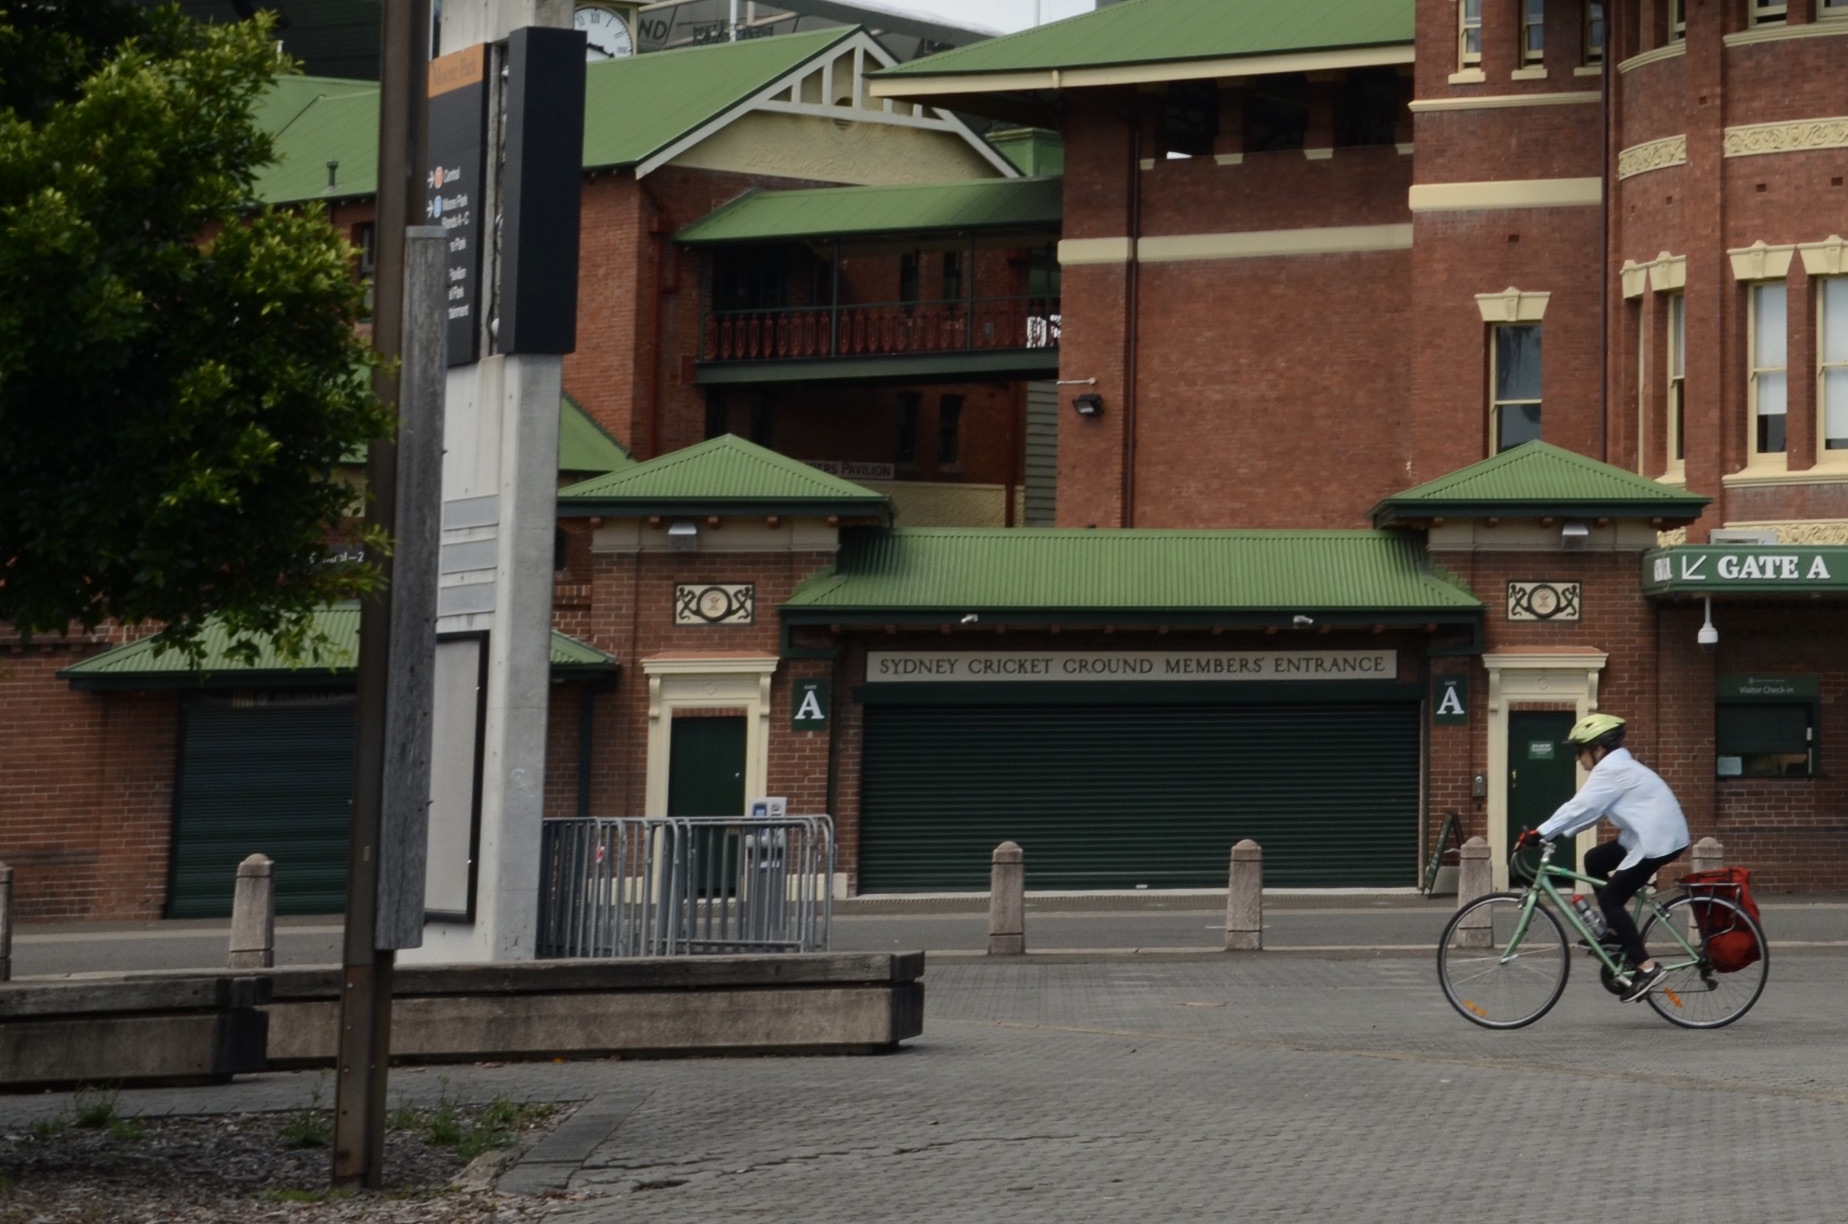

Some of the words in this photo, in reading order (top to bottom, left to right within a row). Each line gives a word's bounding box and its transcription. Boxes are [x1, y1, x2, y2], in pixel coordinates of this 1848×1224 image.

[841, 462, 890, 477] PAVILION
[1717, 555, 1799, 579] GATE
[1806, 555, 1831, 579] A
[880, 659, 958, 674] SYDNEY
[968, 658, 1053, 674] CRICKET
[1062, 658, 1153, 674] GROUND
[1165, 657, 1265, 674] MEMBERS'
[1274, 656, 1385, 673] ENTRANCE
[1739, 685, 1762, 694] Visitor
[1763, 685, 1794, 694] Check-in
[794, 690, 825, 720] A
[1436, 686, 1465, 715] A
